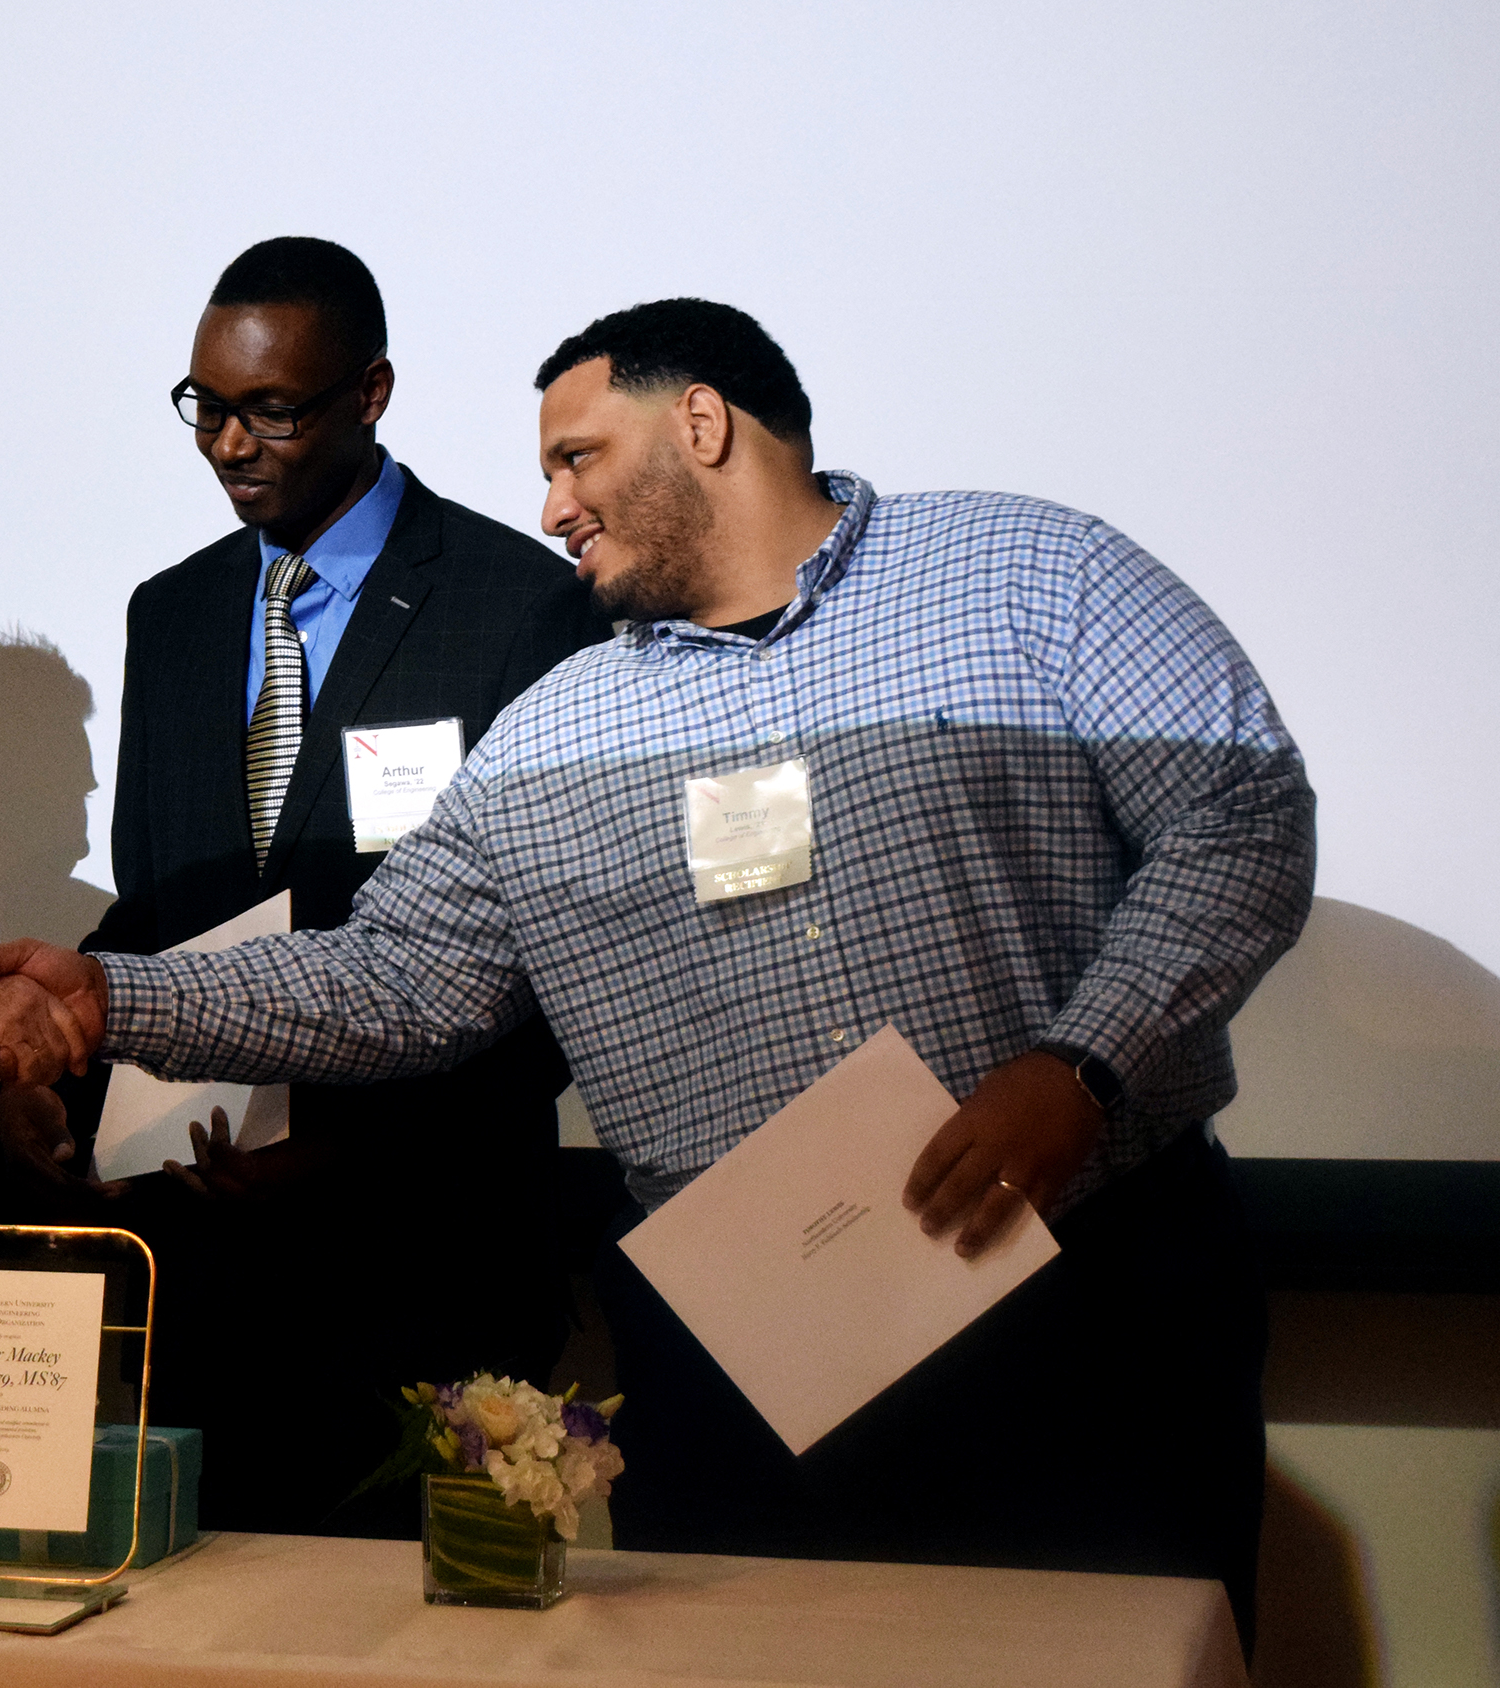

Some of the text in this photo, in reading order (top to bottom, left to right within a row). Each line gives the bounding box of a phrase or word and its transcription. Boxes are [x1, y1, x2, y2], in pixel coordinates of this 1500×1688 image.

[382, 765, 424, 778] Arthur
[384, 779, 412, 788] Segawa,
[373, 788, 395, 796] College
[402, 785, 437, 795] Engineering
[723, 807, 770, 824] Timmy
[15, 1299, 55, 1308] UNIVERSITY
[6, 1346, 62, 1368] Mackey
[18, 1370, 68, 1392] MS'87
[21, 1405, 50, 1414] ALUMNA
